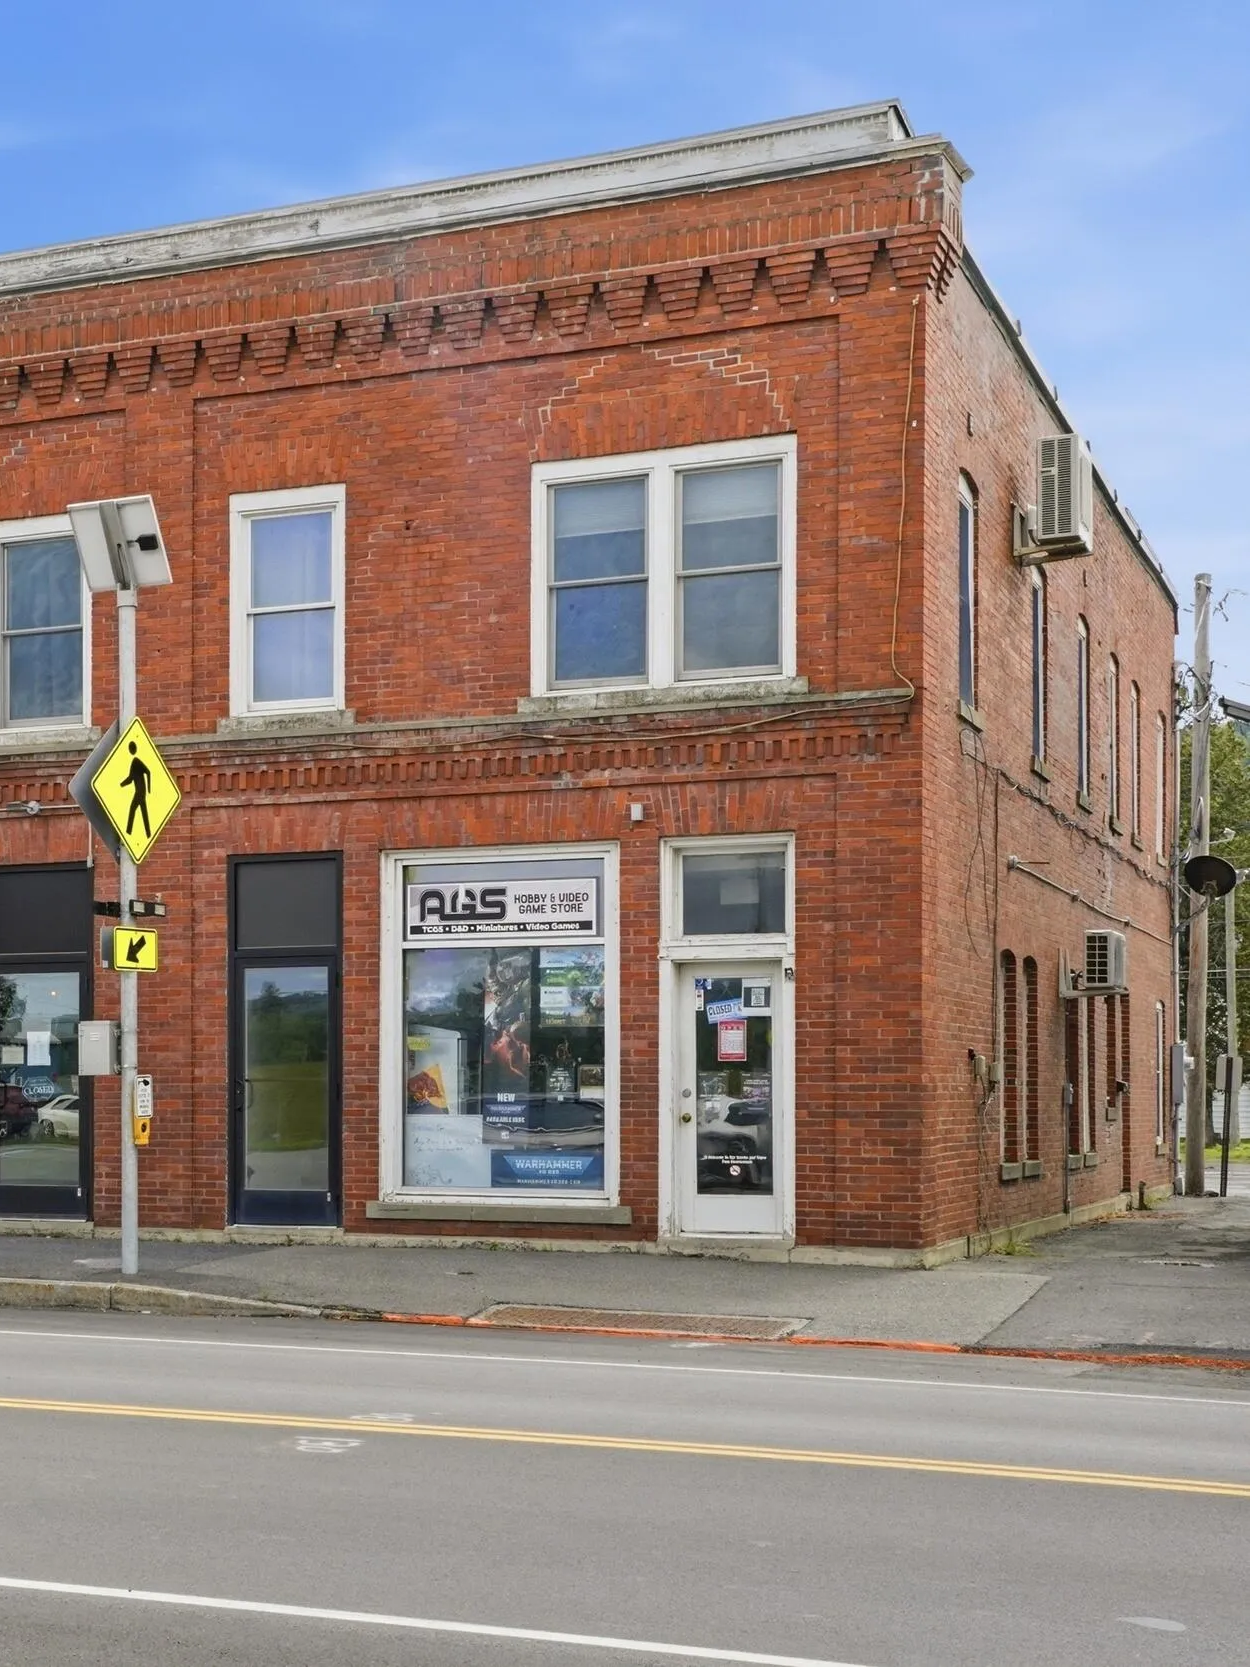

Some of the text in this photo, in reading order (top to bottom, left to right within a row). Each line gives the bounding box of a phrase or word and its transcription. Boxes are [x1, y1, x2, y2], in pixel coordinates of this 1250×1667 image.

[514, 892, 589, 904] HOBBY & VIDEO
[420, 888, 507, 922] AGS
[519, 903, 584, 914] GAME STORE
[476, 923, 518, 932] Miniatures
[526, 923, 550, 931] Video
[551, 922, 580, 930] Games
[708, 1003, 733, 1016] CLOSED
[497, 1093, 516, 1102] NEW
[515, 1160, 582, 1169] WARHAMMER
